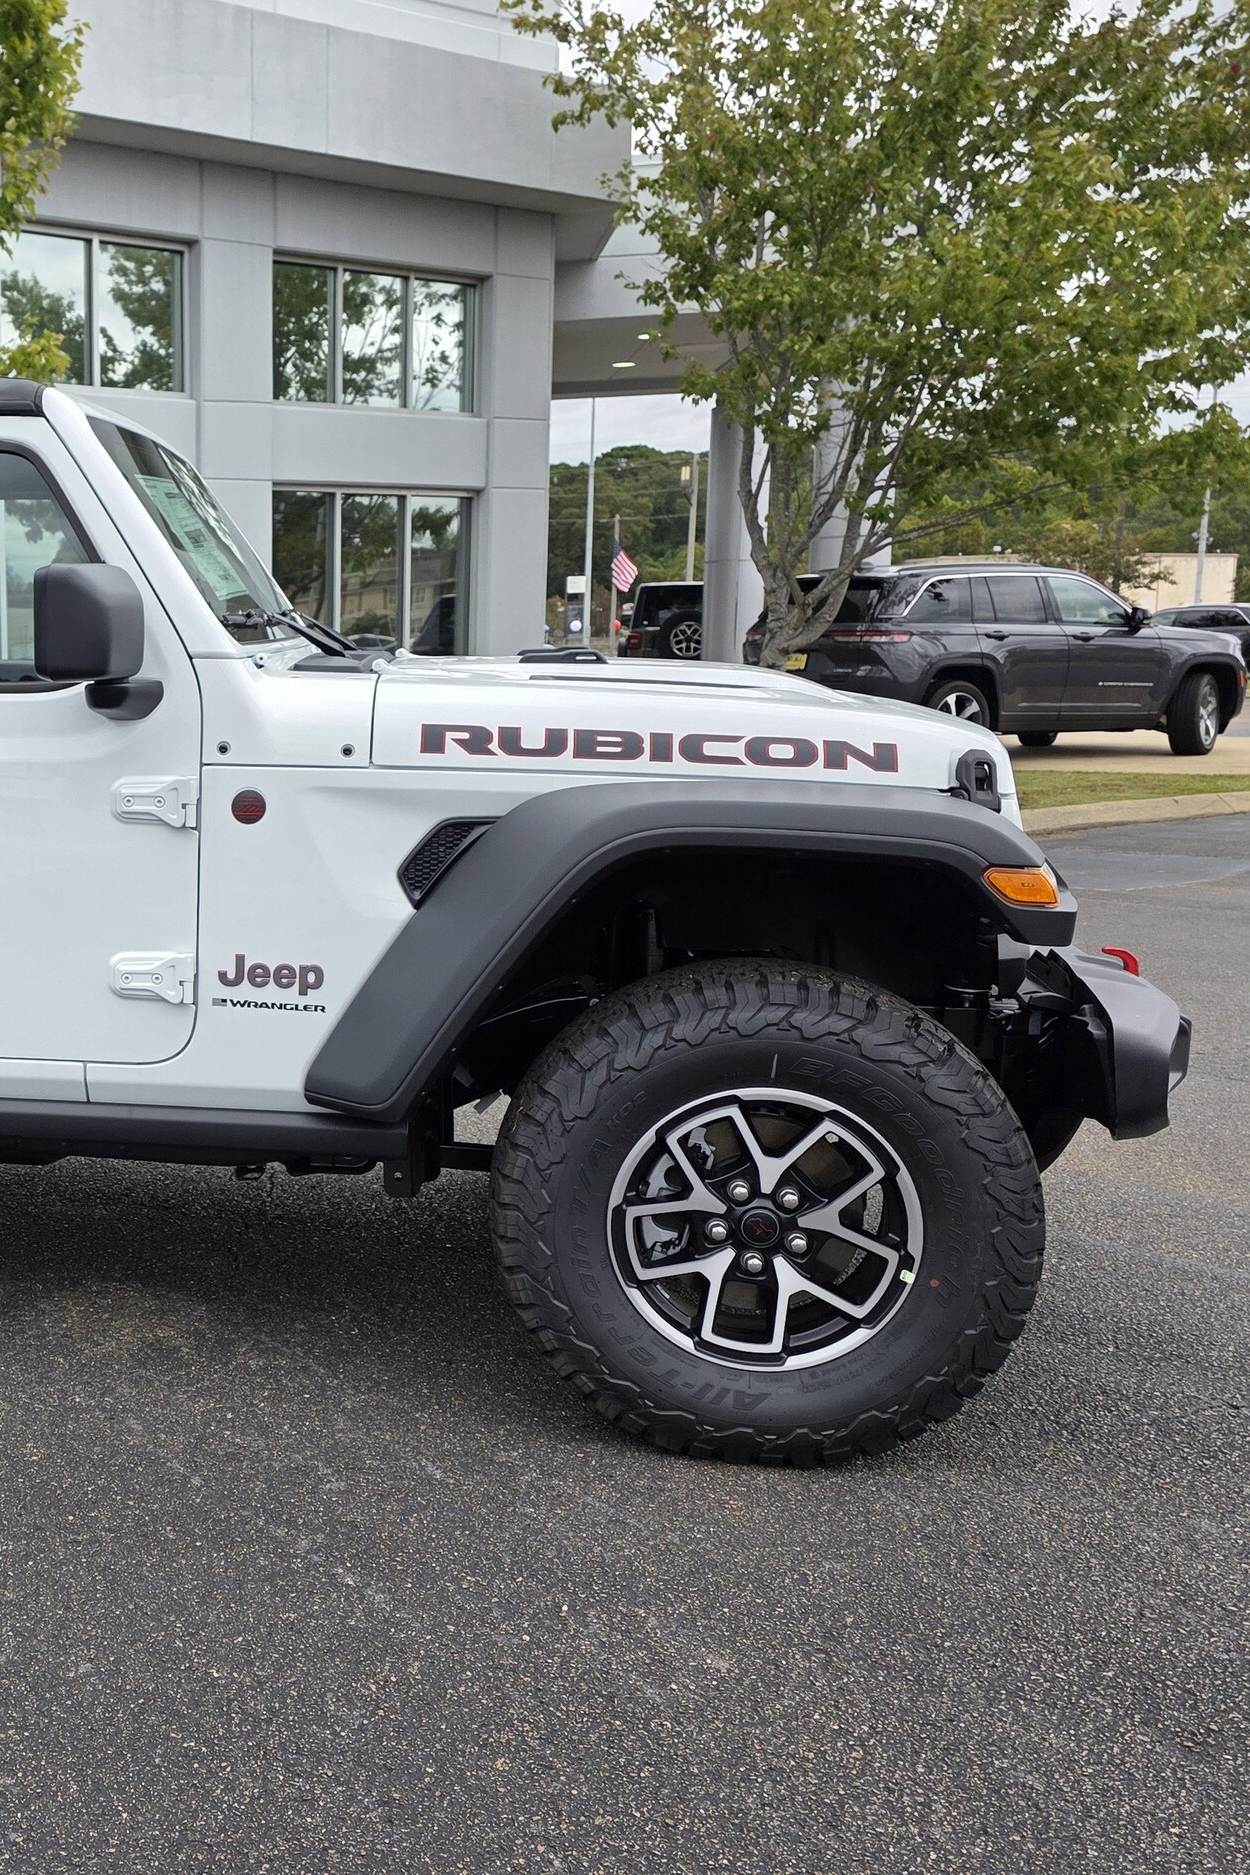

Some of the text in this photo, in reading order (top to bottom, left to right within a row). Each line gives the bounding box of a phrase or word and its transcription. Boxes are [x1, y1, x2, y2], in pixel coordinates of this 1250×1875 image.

[420, 723, 899, 773] RUBICON
[217, 953, 325, 996] Jeep
[229, 998, 327, 1013] WRANGLER
